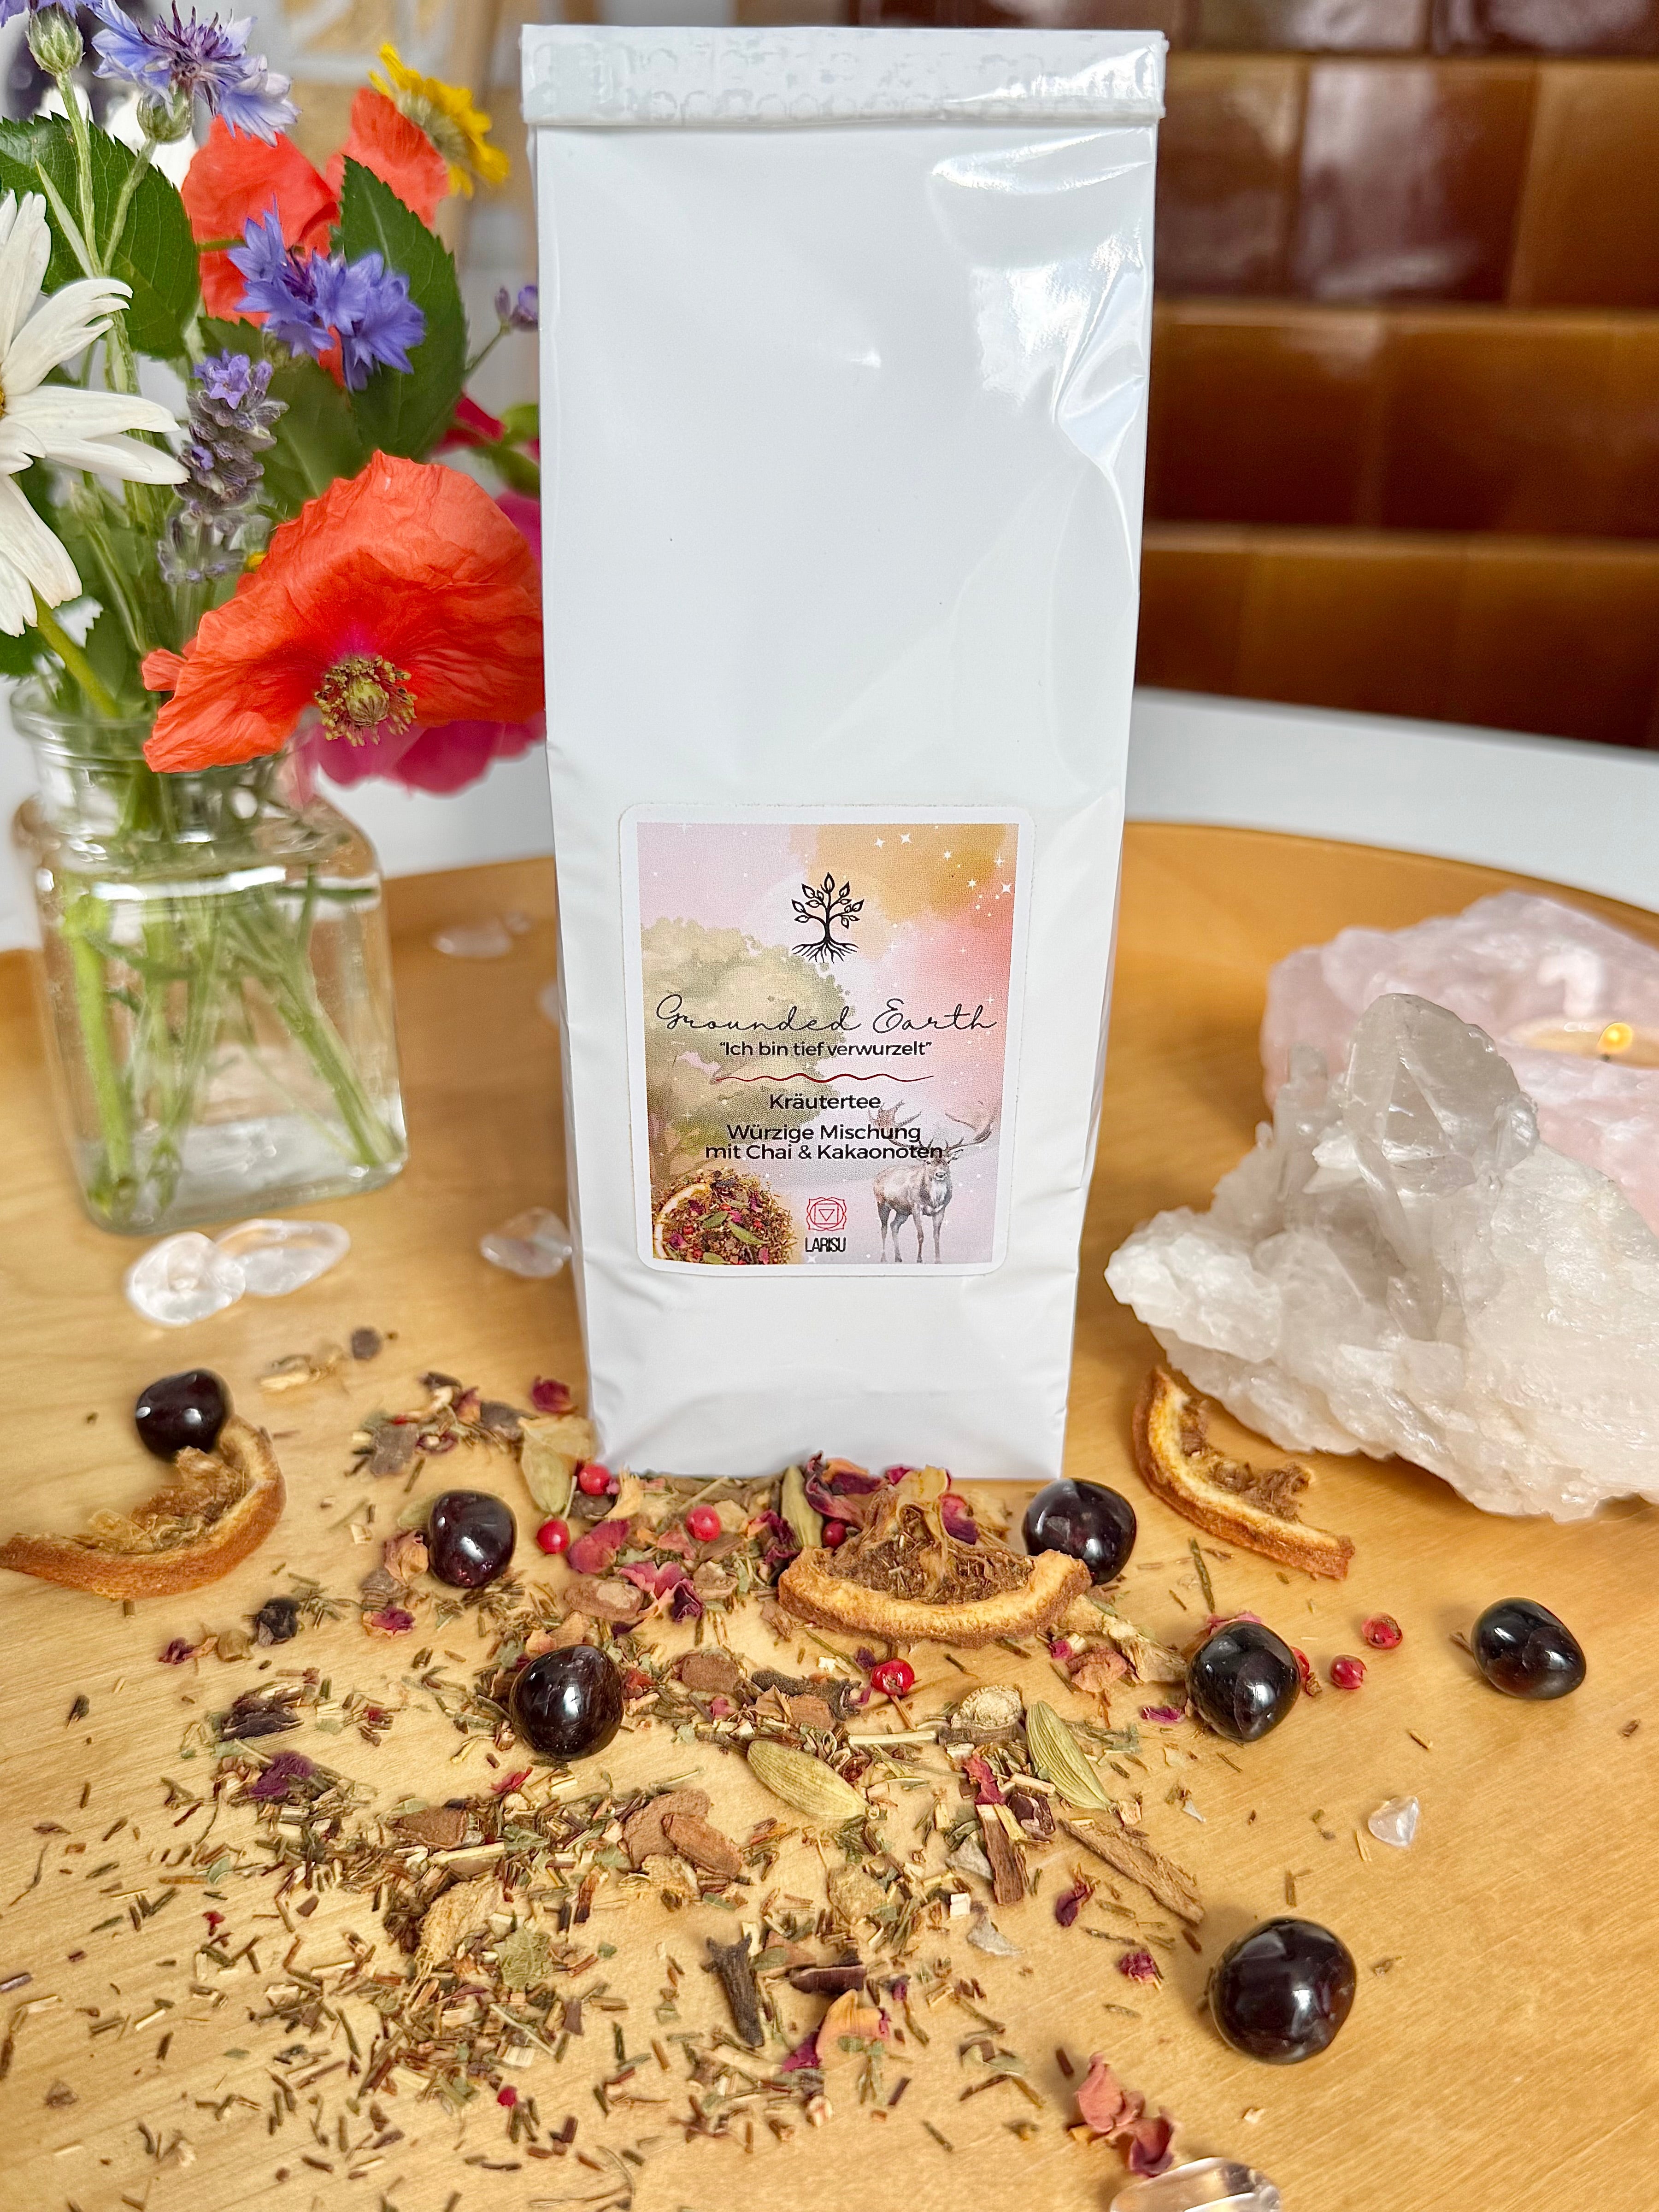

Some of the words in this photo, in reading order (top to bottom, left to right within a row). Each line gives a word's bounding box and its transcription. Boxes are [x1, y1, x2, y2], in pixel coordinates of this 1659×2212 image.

[655, 994, 862, 1031] Grounded
[872, 998, 998, 1034] Earth
[758, 1041, 788, 1057] bin
[792, 1041, 824, 1057] tief
[769, 1093, 882, 1110] Kräutertee
[726, 1123, 815, 1143] Würzige
[820, 1124, 921, 1143] Mischung
[705, 1143, 741, 1160] mit
[745, 1143, 792, 1160] Chai
[797, 1144, 812, 1160] &
[817, 1143, 943, 1160] Kakaonoten
[805, 1237, 846, 1252] LARISU
